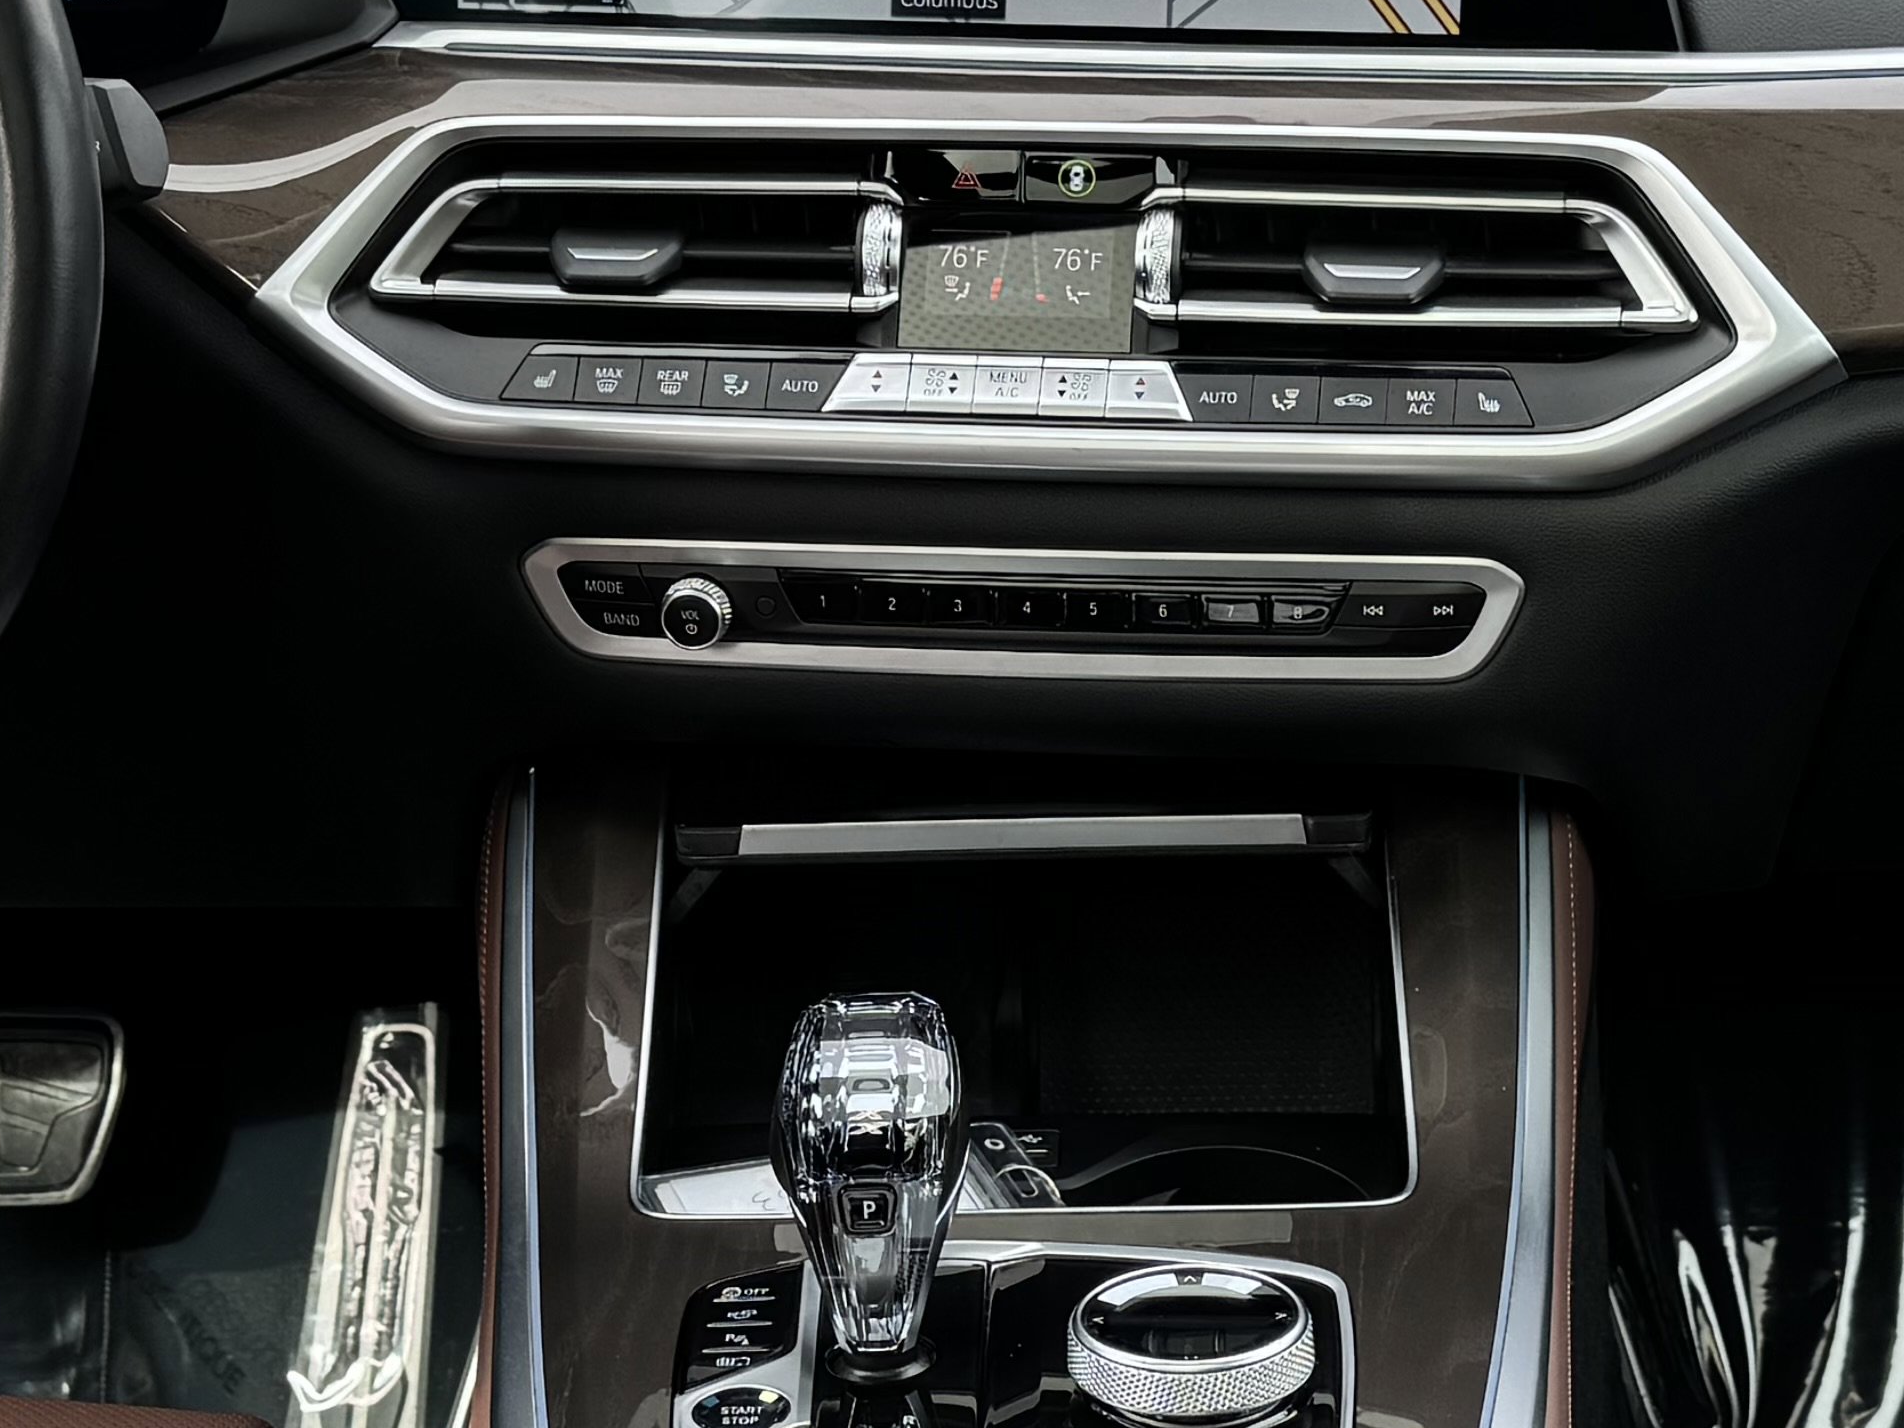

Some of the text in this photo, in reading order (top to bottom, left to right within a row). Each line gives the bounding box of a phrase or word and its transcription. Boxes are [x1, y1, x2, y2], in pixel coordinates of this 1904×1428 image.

[594, 367, 624, 380] MAX
[656, 369, 689, 382] REAR
[781, 378, 819, 393] AUTO
[1198, 391, 1238, 405] AUTO
[1405, 390, 1436, 403] MAX
[1407, 402, 1434, 416] A/C
[584, 579, 625, 596] MODE
[887, 597, 897, 612] 2
[953, 599, 963, 613] 3
[1022, 600, 1032, 615] 4
[1088, 602, 1098, 616] 5
[1158, 603, 1168, 618] 6
[602, 611, 640, 628] BAND
[862, 1200, 876, 1219] P
[720, 1405, 764, 1415] START
[721, 1415, 759, 1425] STOP
